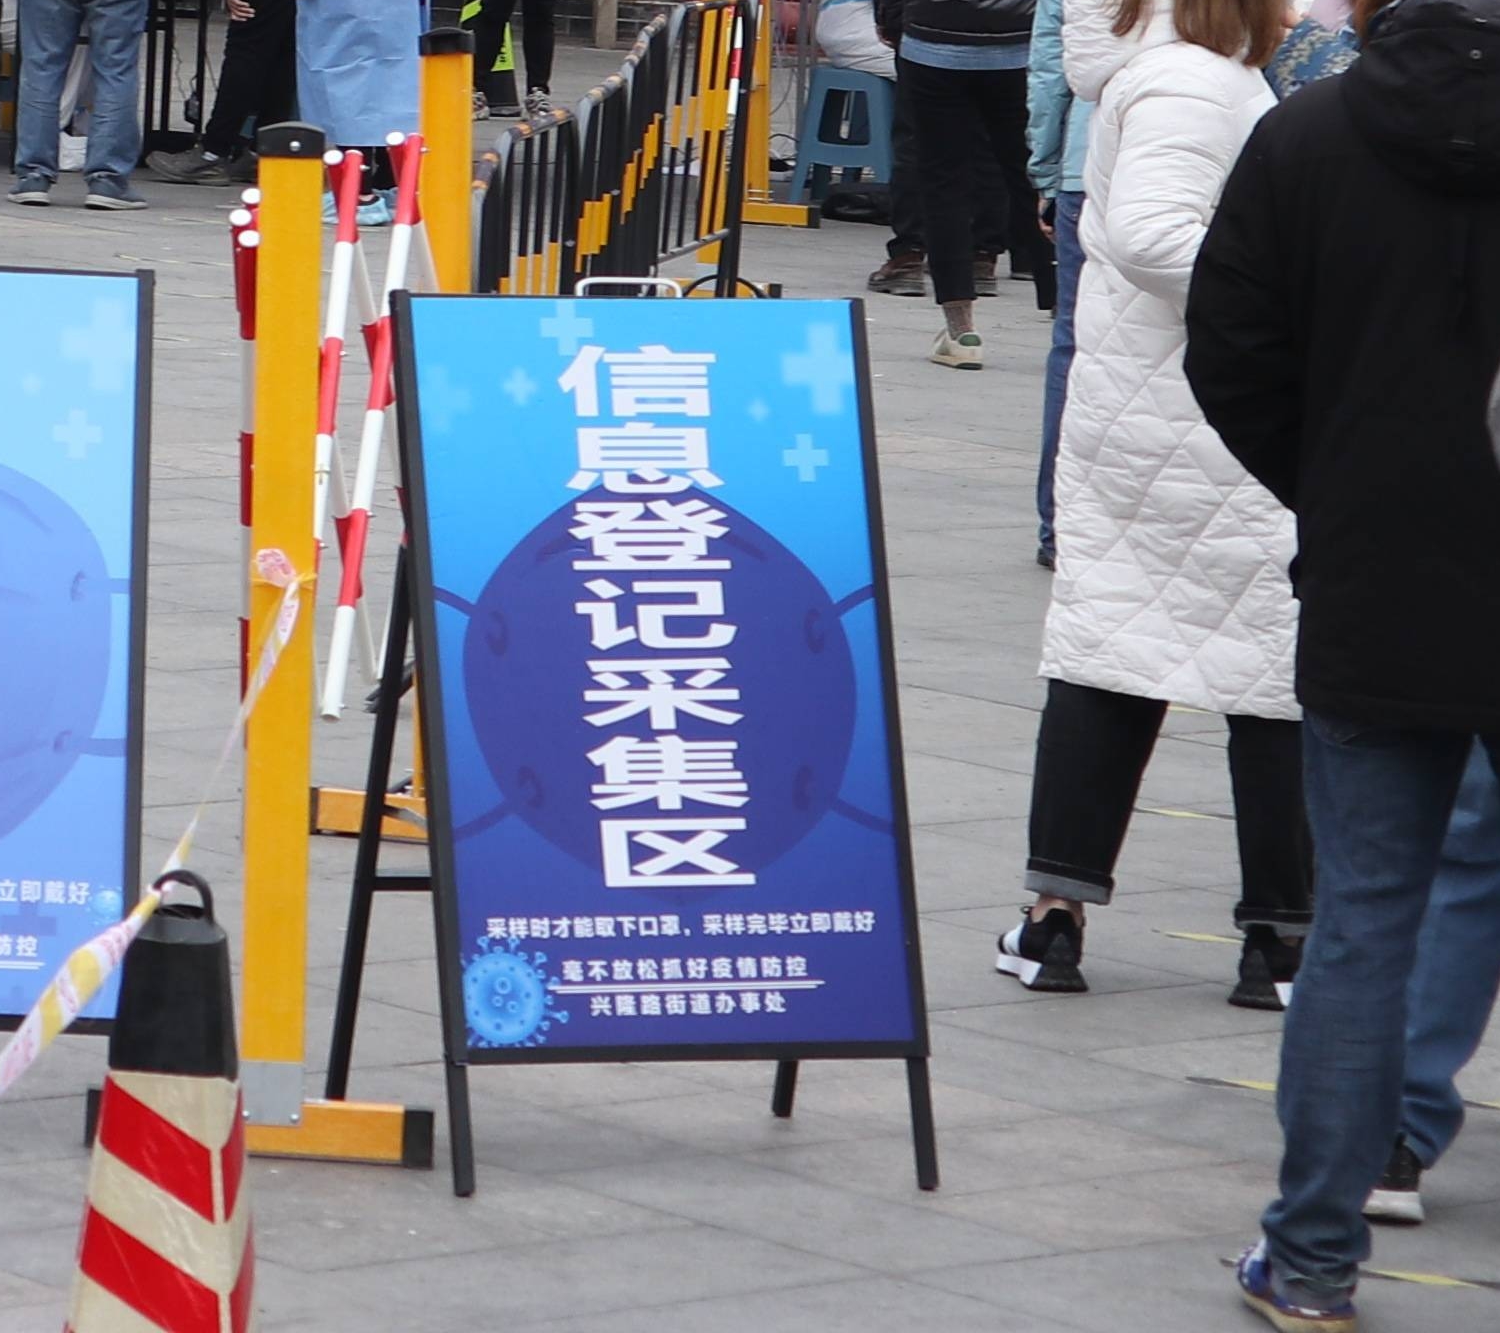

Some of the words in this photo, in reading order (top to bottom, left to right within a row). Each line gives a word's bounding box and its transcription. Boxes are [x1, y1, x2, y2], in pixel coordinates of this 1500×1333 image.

[557, 344, 757, 888] 信息登记采集区
